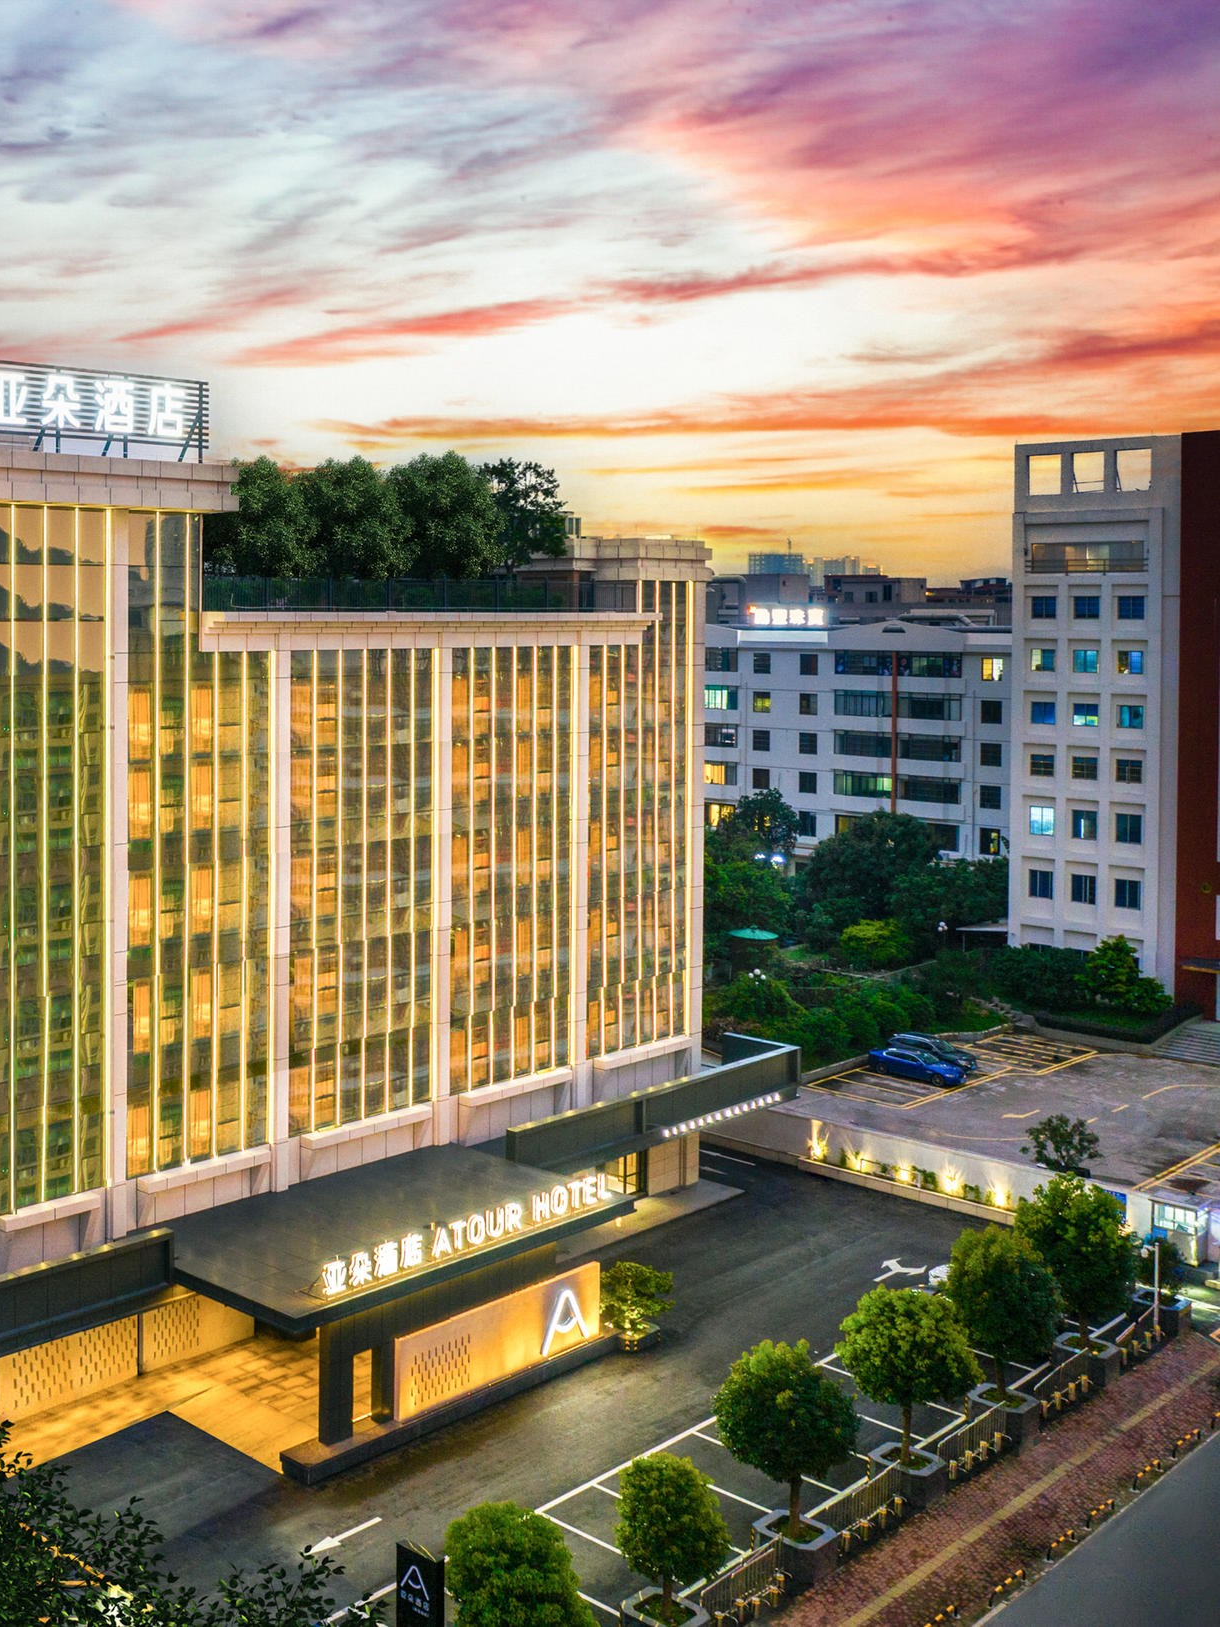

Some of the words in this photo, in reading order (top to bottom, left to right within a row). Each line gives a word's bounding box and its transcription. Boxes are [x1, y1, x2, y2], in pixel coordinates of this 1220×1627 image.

[321, 1232, 423, 1295] 亚朵酒店
[431, 1200, 523, 1258] ATOUR
[532, 1173, 612, 1222] HOTEL
